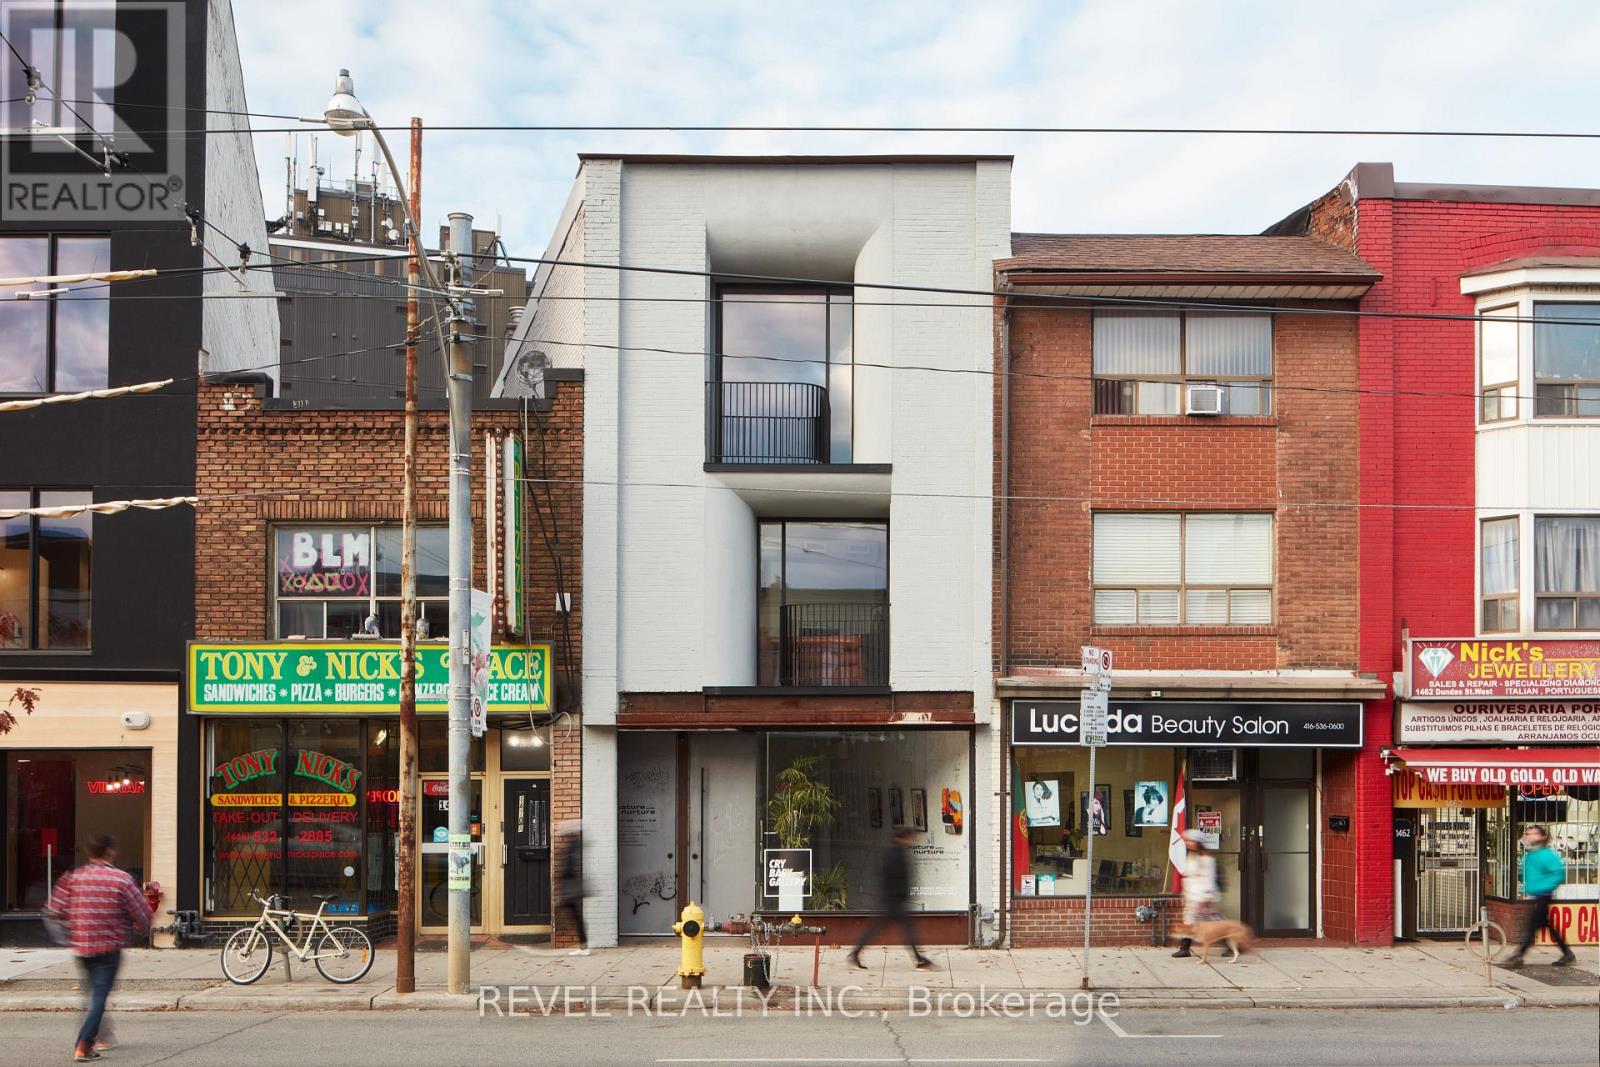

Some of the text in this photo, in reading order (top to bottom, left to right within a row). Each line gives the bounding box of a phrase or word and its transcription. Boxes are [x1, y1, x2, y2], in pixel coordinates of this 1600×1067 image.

[293, 532, 370, 567] BLM
[1460, 642, 1544, 662] Nick's
[200, 651, 288, 681] TONY
[296, 655, 318, 677] &
[1468, 662, 1596, 679] JEWELLERY
[1429, 680, 1457, 688] SALES
[1504, 679, 1561, 687] SPECIALIZING
[203, 683, 276, 702] SANDWICHES
[290, 683, 322, 702] PIZZA
[334, 683, 384, 702] BURGERS
[501, 683, 539, 701] CREAM
[1435, 688, 1463, 696] Dundas
[1453, 704, 1566, 714] OURIVESARIA
[1029, 708, 1345, 738] Lucda Beauty Salon 416-536-0600
[215, 748, 363, 793] TONY NICK'S
[1426, 767, 1448, 782] WE
[1451, 767, 1477, 782] BUY
[1480, 767, 1506, 783] OLD
[1510, 768, 1549, 784] GOLD,
[1552, 768, 1578, 782] OLD
[1519, 784, 1561, 795] OPEN
[217, 795, 349, 807] SANDWICHES & PIZZERIA
[291, 811, 358, 823] DELIVERY
[253, 831, 278, 843] 532
[769, 859, 786, 869] CRY
